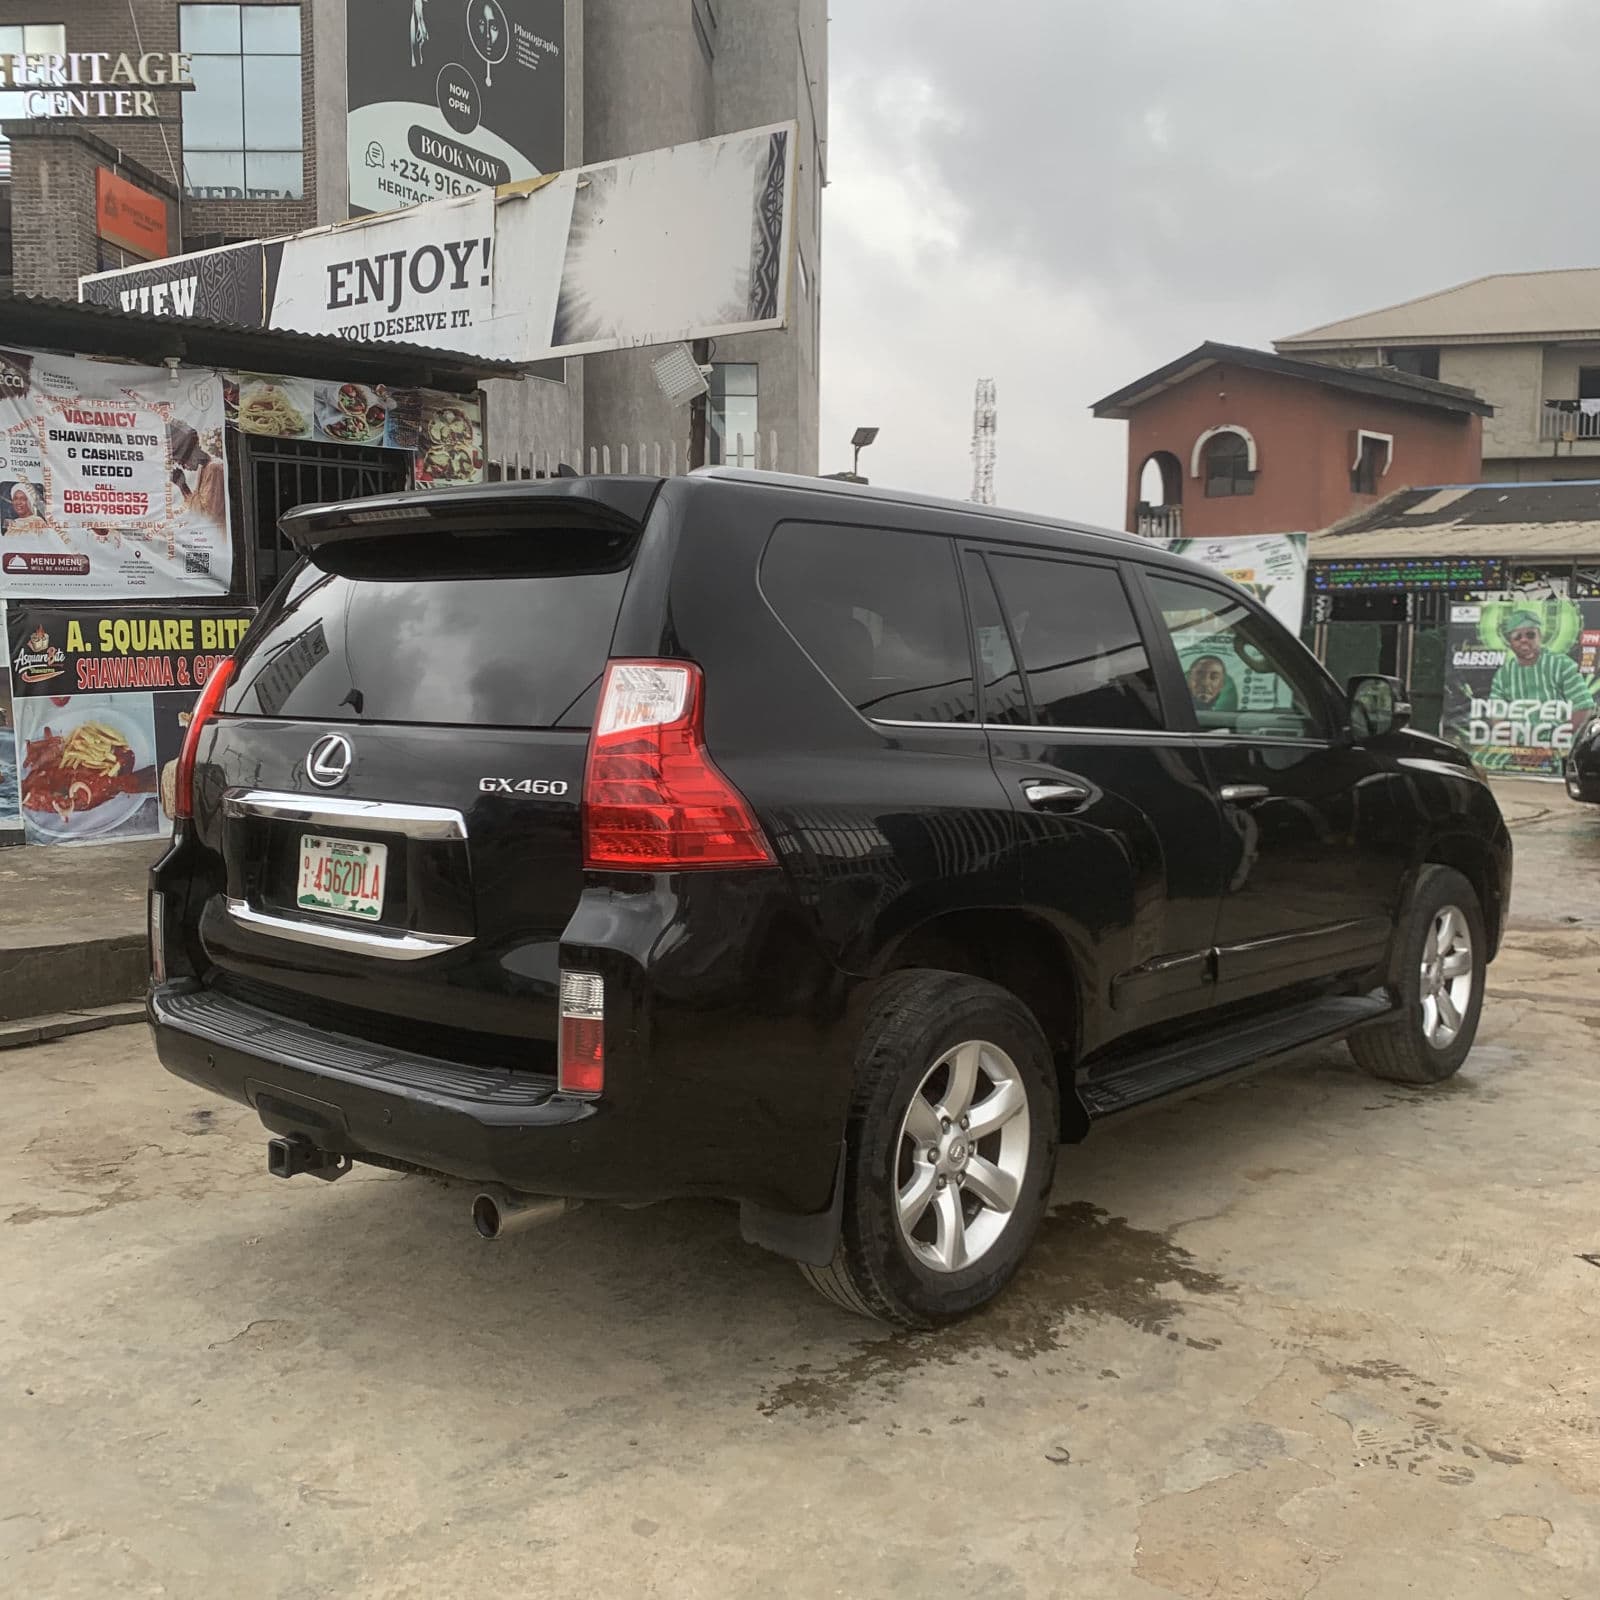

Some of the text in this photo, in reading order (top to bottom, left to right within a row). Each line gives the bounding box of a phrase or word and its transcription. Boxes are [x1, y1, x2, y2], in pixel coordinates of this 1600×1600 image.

[514, 23, 559, 56] Photography
[449, 83, 470, 100] NOW
[24, 90, 156, 118] CENTER
[448, 98, 470, 115] OPEN
[421, 135, 500, 181] BOOK NOW
[390, 158, 430, 187] +234
[434, 172, 461, 197] 916
[326, 238, 491, 310] ENJOY!
[119, 276, 198, 317] VIEW
[338, 309, 473, 342] YOU DESERVE IT.
[62, 409, 137, 428] VACANCY
[48, 429, 158, 446] SHAWARMA BOYS
[81, 448, 145, 461] CASHIERS
[81, 465, 133, 477] NEEDED
[63, 489, 149, 503] 08165008352
[63, 502, 149, 515] 08137985057
[30, 557, 83, 567] MENU MENU
[66, 621, 92, 653] A.
[98, 619, 194, 654] SQUARE
[1453, 651, 1506, 667] GABSON
[77, 657, 175, 690] SHAWARMA
[177, 656, 190, 686] &
[1469, 720, 1574, 748] DENCE
[479, 777, 569, 796] GX460
[313, 857, 380, 900] 4562DLA
